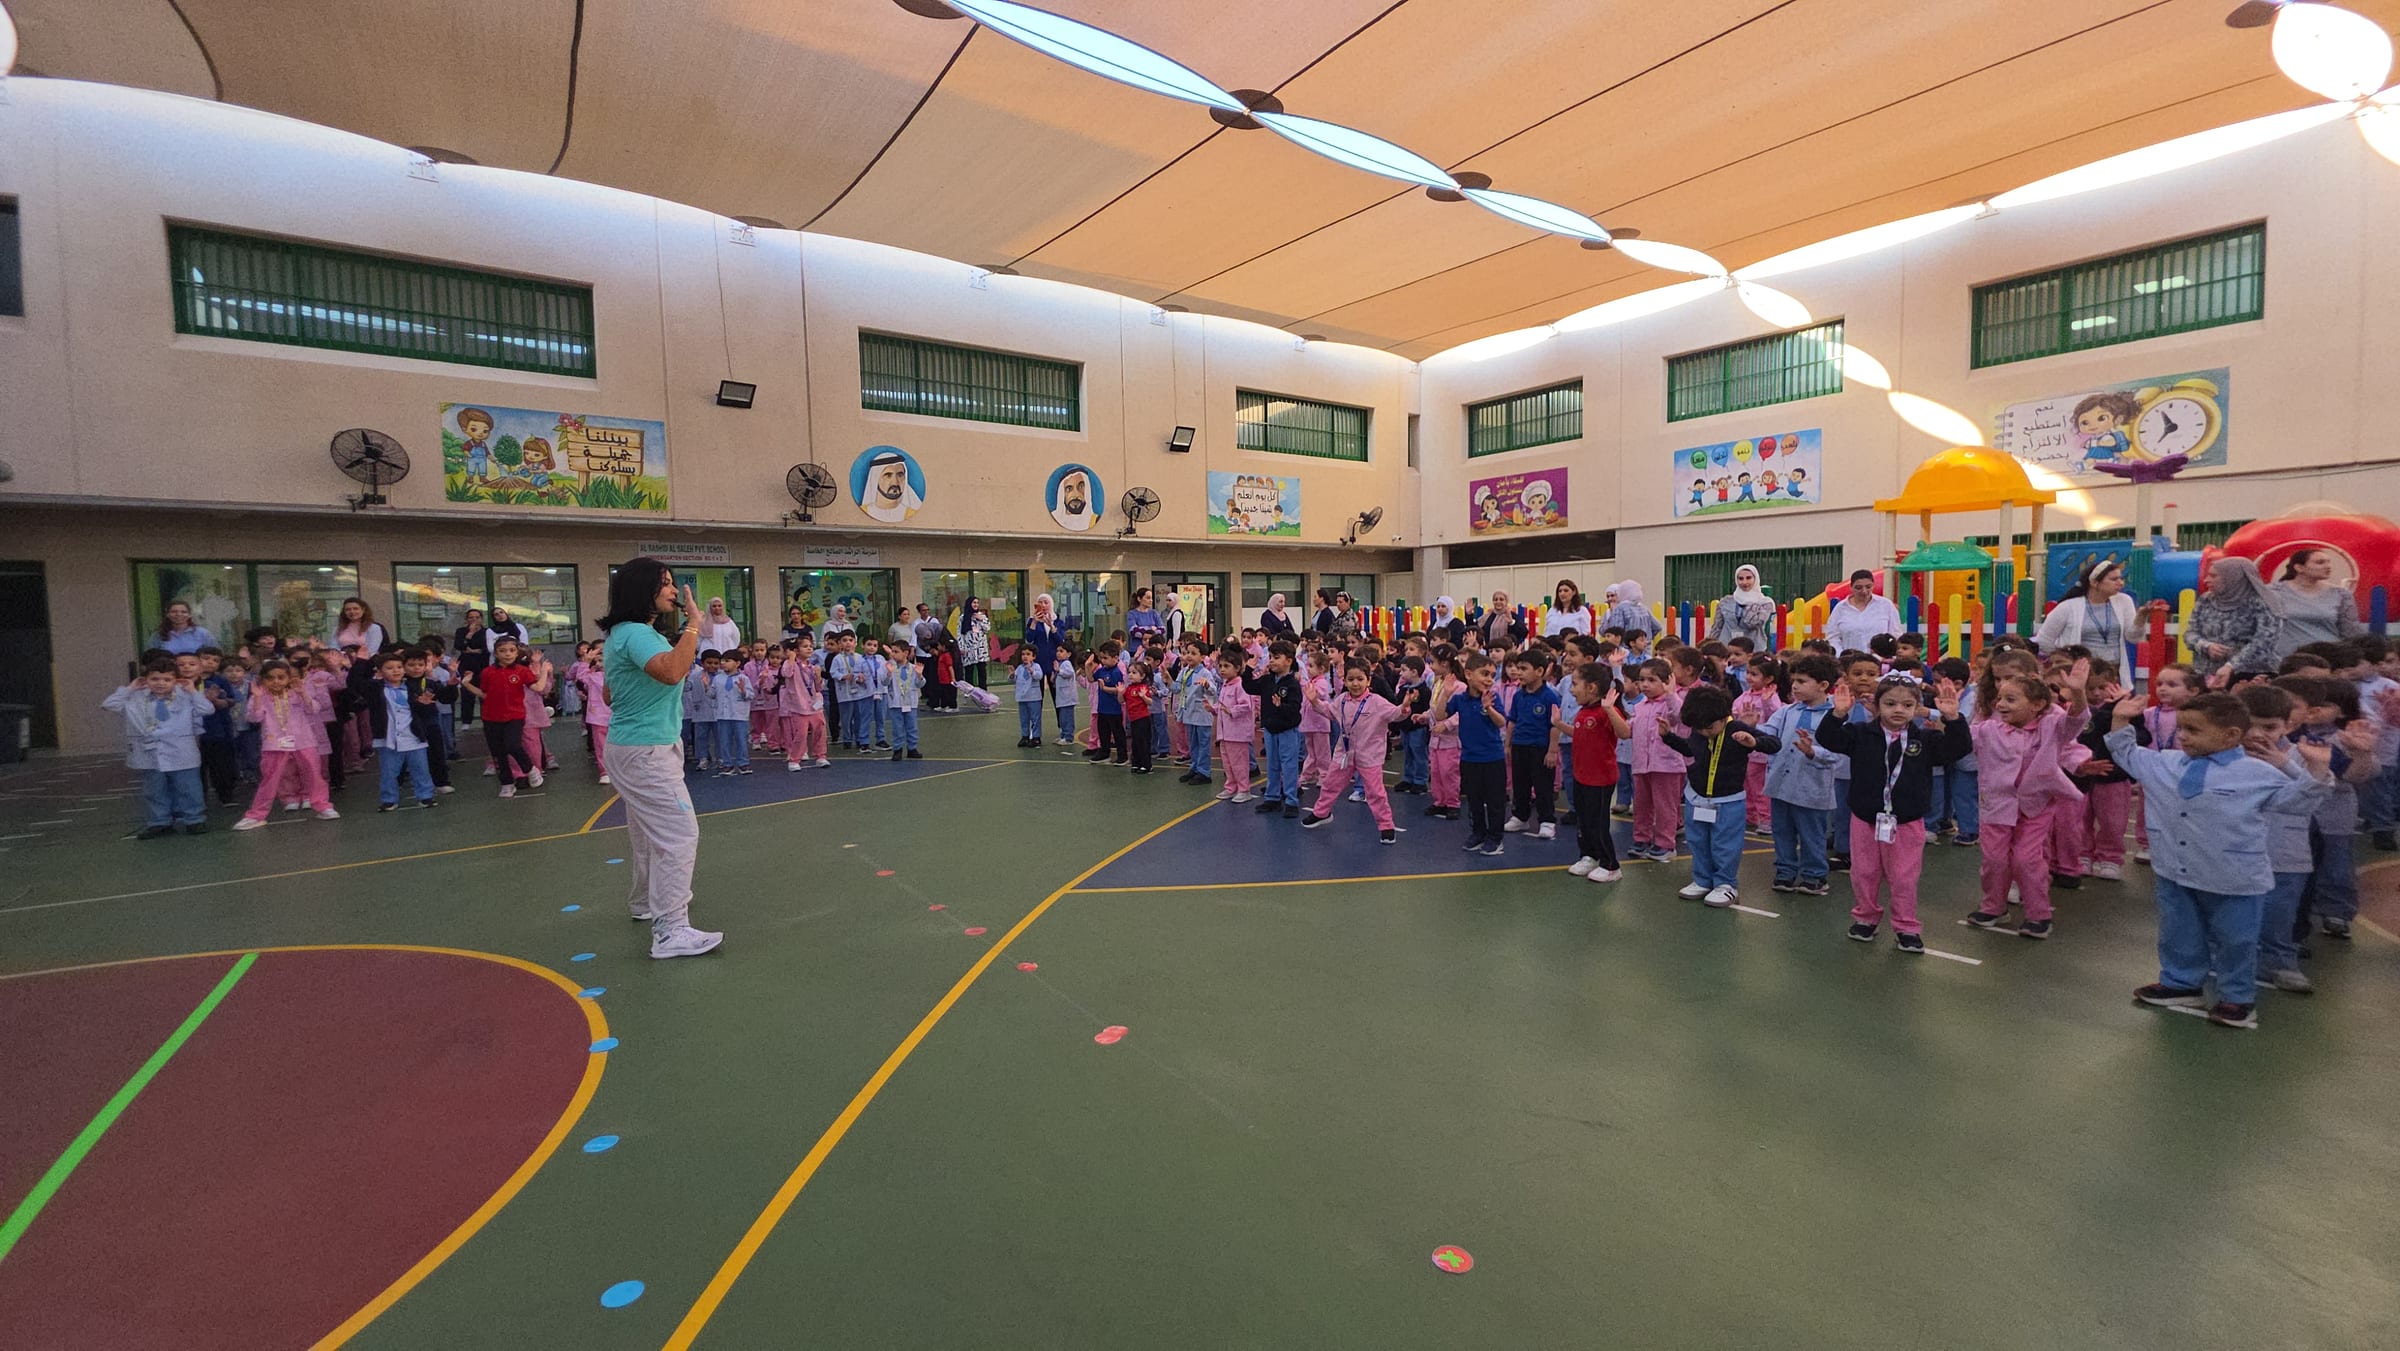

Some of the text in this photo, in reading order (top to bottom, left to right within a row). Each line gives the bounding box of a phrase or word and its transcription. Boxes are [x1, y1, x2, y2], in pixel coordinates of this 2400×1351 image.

[2035, 403, 2054, 416] نعم
[584, 445, 632, 460] جميلة
[586, 458, 636, 476] بسلوكنا
[1256, 493, 1266, 502] يوم
[1267, 491, 1276, 501] كل
[706, 545, 727, 554] SCHOOL
